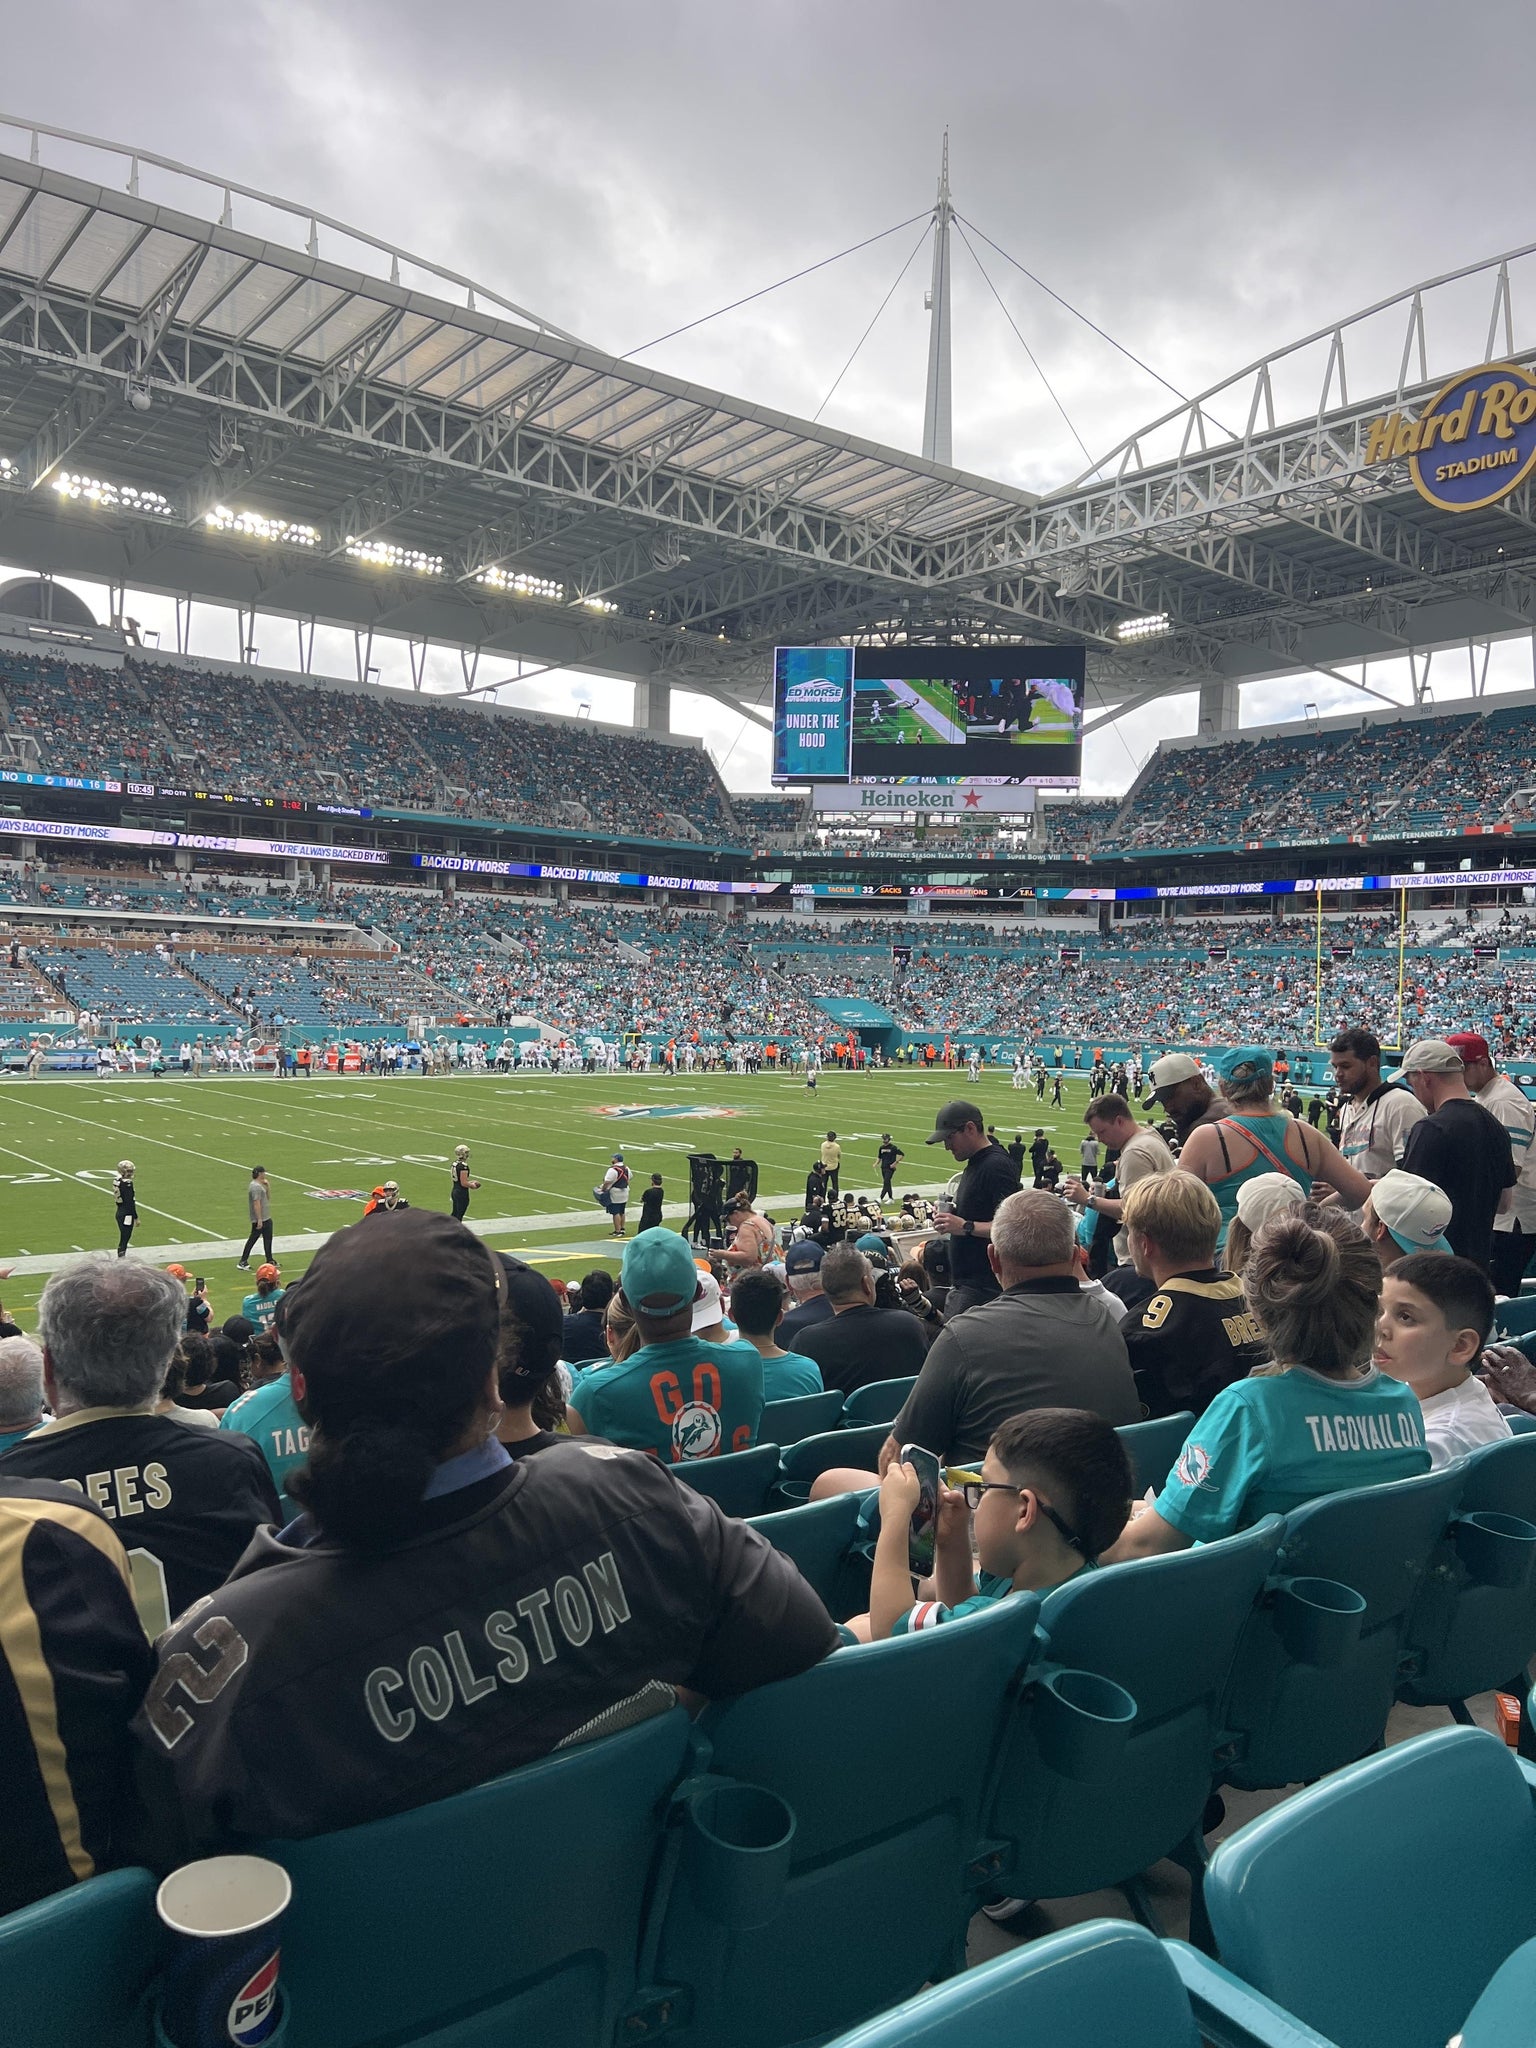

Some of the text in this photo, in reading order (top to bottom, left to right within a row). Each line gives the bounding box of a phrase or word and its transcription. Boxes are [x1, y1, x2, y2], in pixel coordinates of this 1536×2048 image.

[1364, 388, 1479, 466] Hard
[1435, 447, 1519, 482] STADIUM
[47, 647, 65, 657] 346
[184, 658, 200, 667] 347
[788, 688, 842, 697] ED MORSE
[1419, 706, 1433, 715] 302
[786, 713, 840, 729] UNDER THE
[799, 732, 826, 748] HOOD
[2, 772, 19, 782] NO
[26, 774, 33, 783] 0
[65, 777, 84, 788] MIA
[89, 780, 101, 789] 16
[863, 776, 877, 784] NO
[888, 776, 895, 784] 0
[921, 776, 938, 784] MIA
[946, 776, 956, 784] 16
[129, 785, 152, 794] 10:45
[224, 794, 234, 802] 10
[264, 799, 274, 807] 12
[861, 789, 955, 807] Heineken
[22, 821, 62, 835] BACKED
[63, 826, 76, 836] BY
[77, 827, 111, 839] MORSE
[1372, 828, 1457, 842] MANNY FERNANDEZ 75
[153, 832, 237, 850] ED MORSE
[1279, 837, 1330, 848] TIM BOWENS 95
[269, 843, 298, 854] YOU'RE
[299, 846, 332, 858] ALWAYS
[332, 849, 364, 860] BACKED
[364, 852, 375, 861] BY
[886, 851, 910, 859] PERFECT
[911, 851, 936, 859] SEASON
[956, 852, 973, 860] 17-0
[1007, 853, 1026, 861] SUPER
[1027, 853, 1046, 861] BOWL
[421, 855, 511, 875] BACKED BY MORSE
[540, 866, 621, 884] BACKED BY MORSE
[1393, 870, 1534, 886] YOU'RE ALWAYS BACKED BY MORSE
[647, 875, 720, 892] BACKED BY MORSE
[862, 886, 874, 894] 32
[909, 887, 924, 895] 2.0
[936, 888, 988, 896] INTERCEPTIONS
[998, 888, 1004, 897] 1
[1042, 889, 1049, 897] 2
[1156, 882, 1264, 897] YOU'RE ALWAYS BACKED BY MORSE
[1294, 877, 1364, 892] ED MORSE
[832, 1209, 847, 1228] 33
[1142, 1294, 1174, 1329] 9
[650, 1363, 722, 1425] GO
[1305, 1412, 1422, 1452] TAGOVAILOA
[59, 1462, 172, 1519] EES
[364, 1551, 632, 1742] COLSTON
